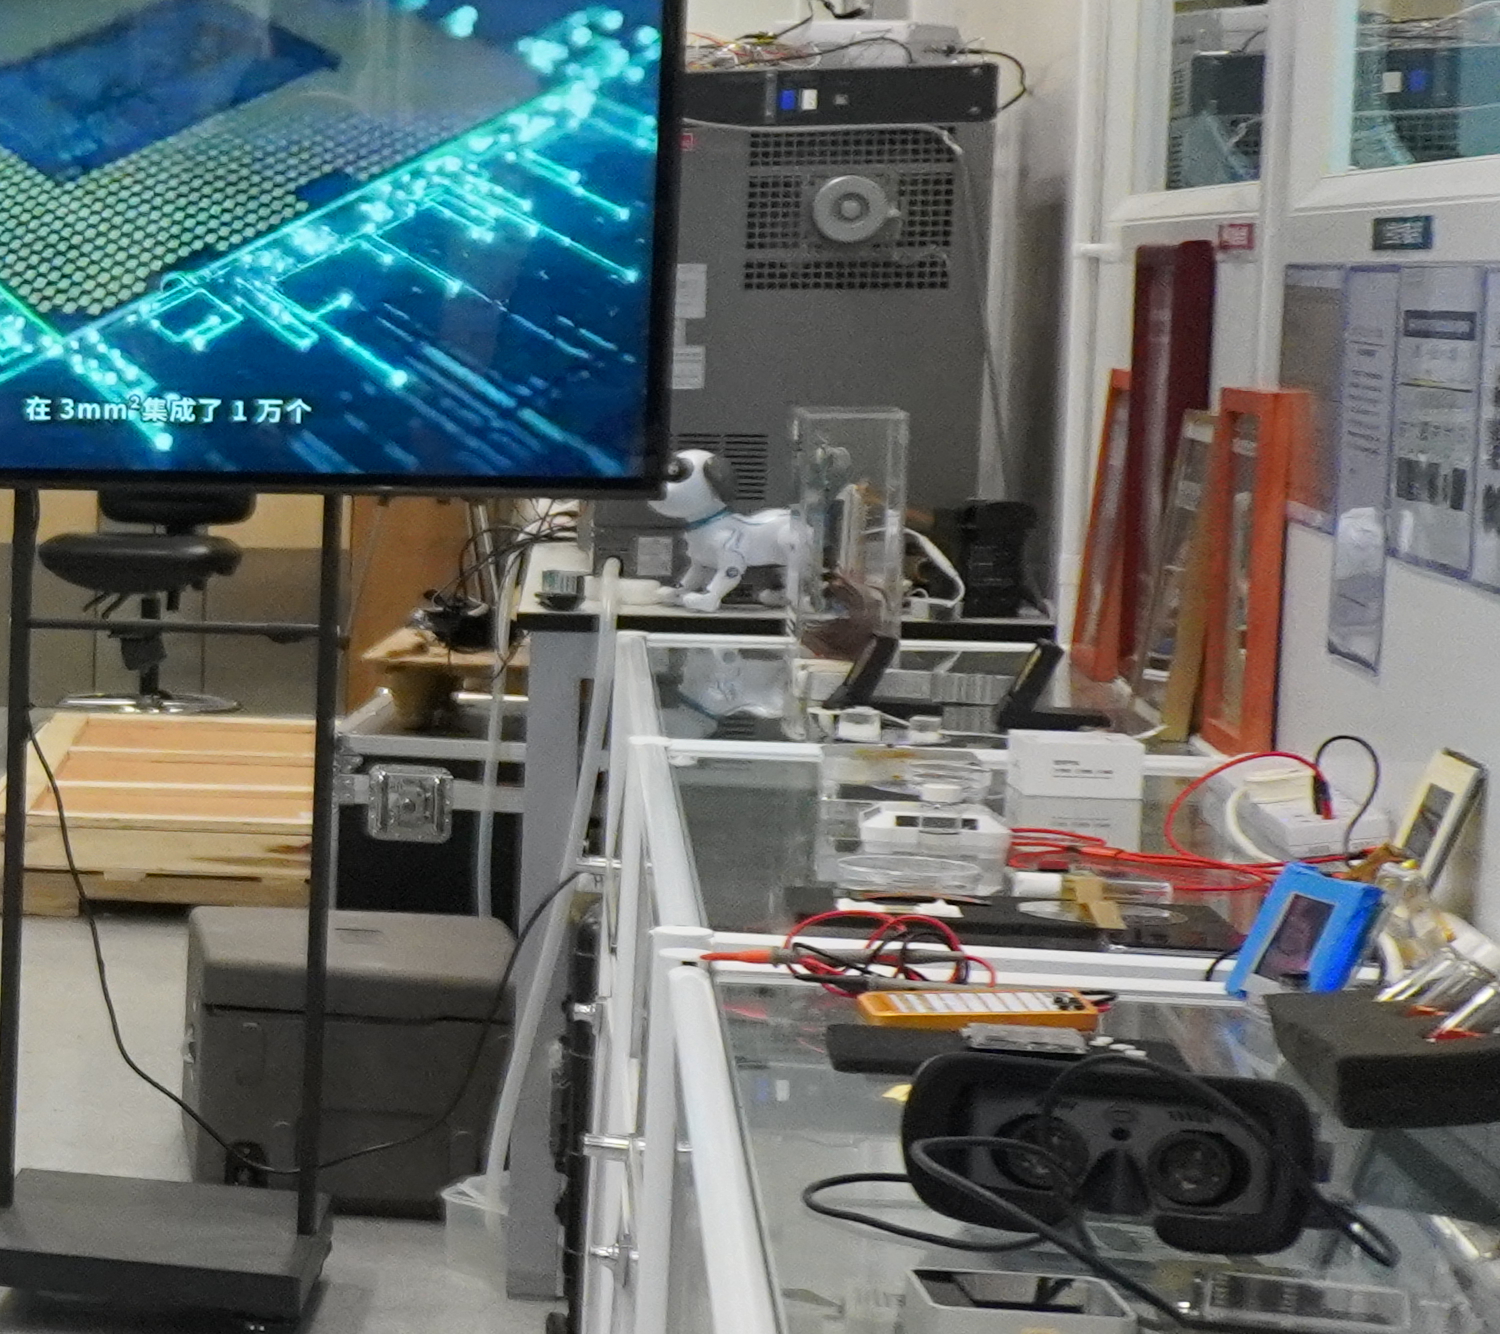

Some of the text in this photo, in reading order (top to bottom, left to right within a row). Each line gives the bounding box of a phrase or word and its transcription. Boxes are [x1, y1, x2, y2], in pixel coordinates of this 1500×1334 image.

[25, 395, 52, 422] 在
[232, 398, 248, 421] 1
[256, 398, 312, 424] 万个
